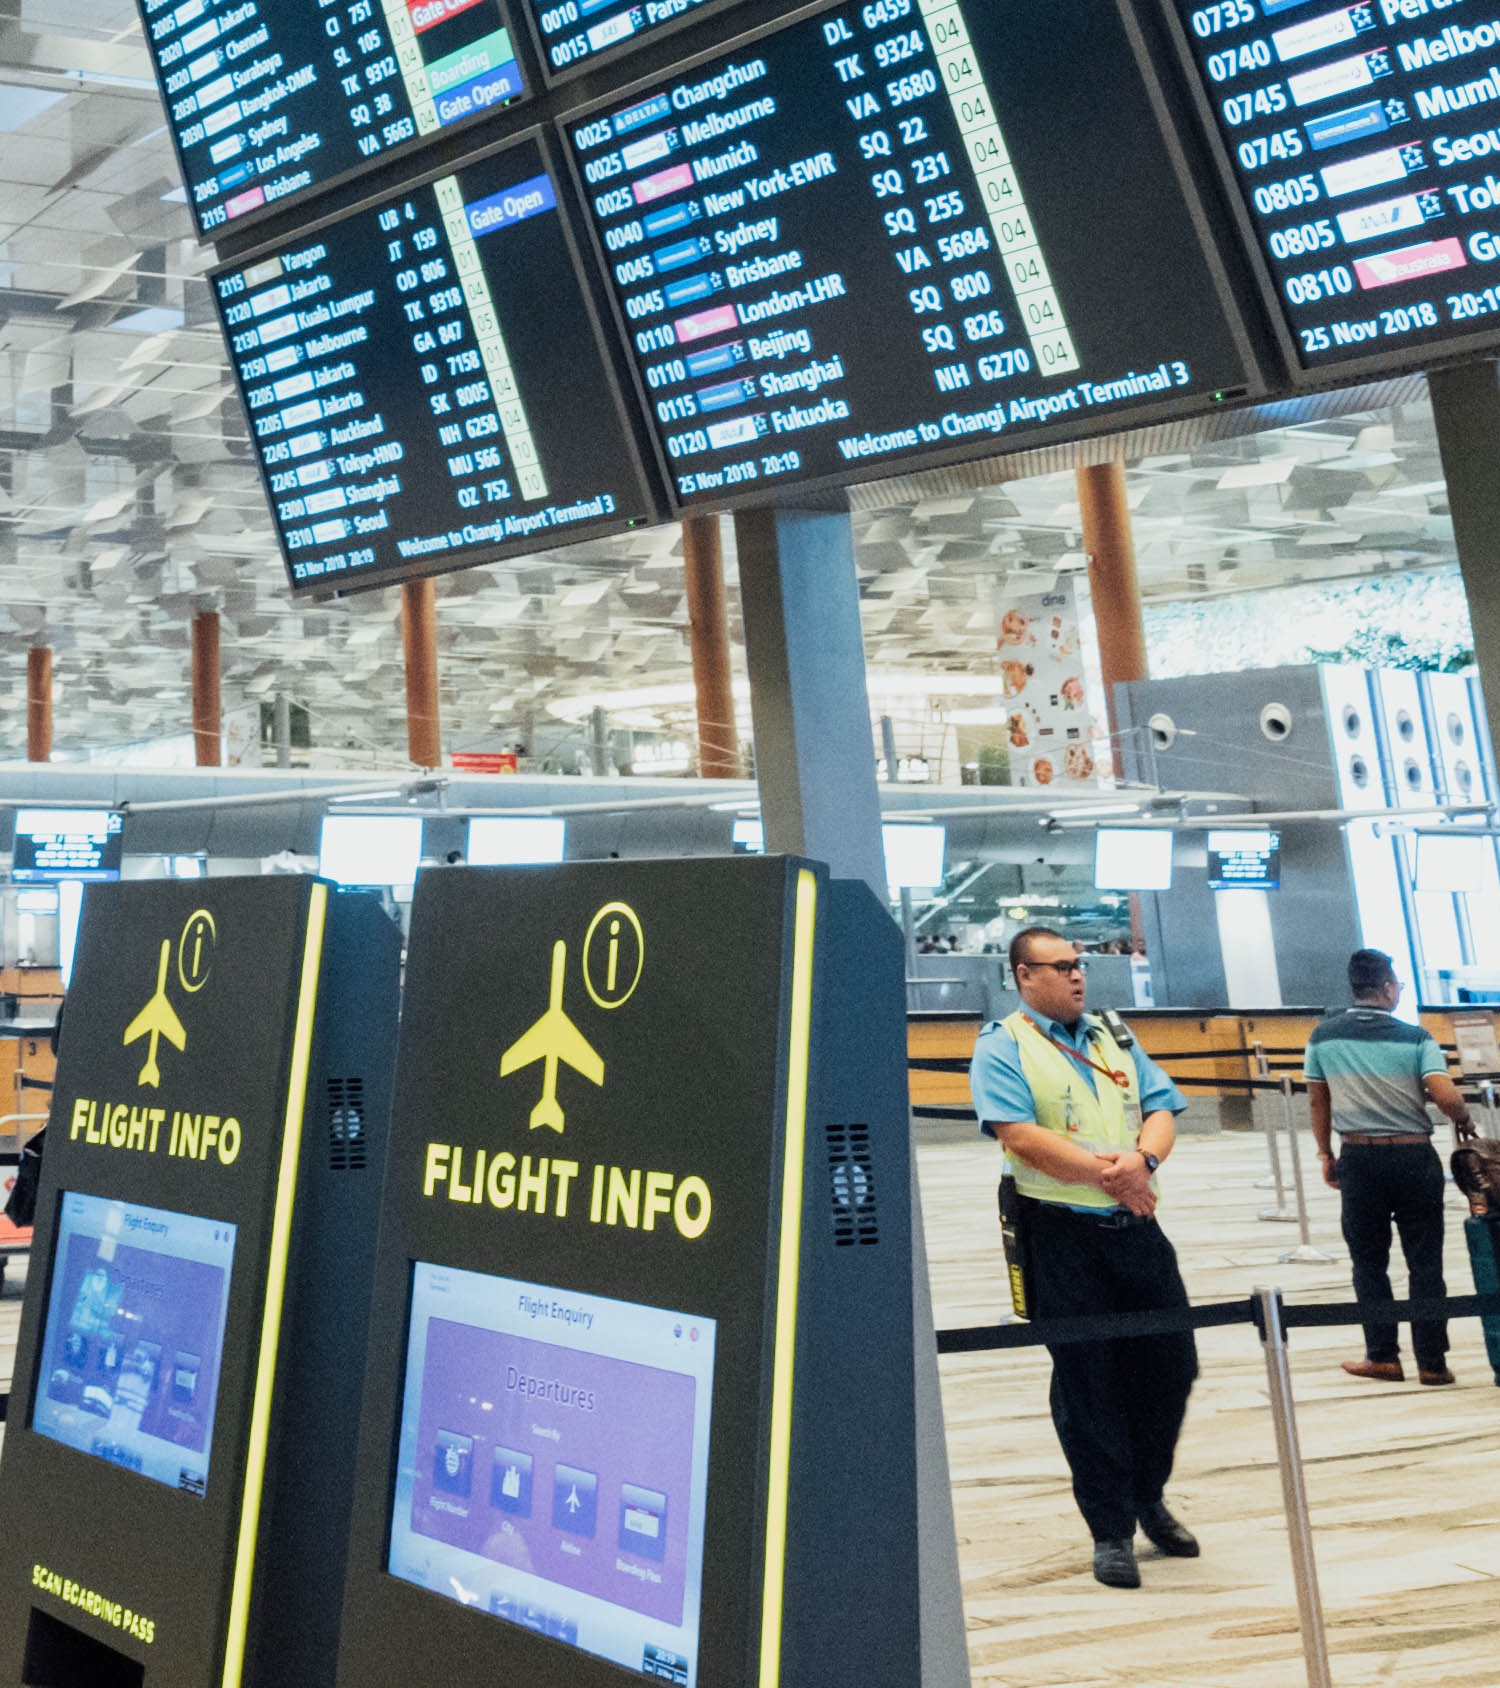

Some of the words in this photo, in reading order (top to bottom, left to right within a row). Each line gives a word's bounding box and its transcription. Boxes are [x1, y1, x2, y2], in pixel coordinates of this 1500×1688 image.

[575, 119, 612, 150] 0025
[672, 59, 766, 110] Changchun
[823, 18, 853, 46] DL
[1286, 266, 1352, 304] 0810
[1300, 326, 1330, 352] 25
[1331, 320, 1378, 345] Nov
[1379, 302, 1438, 335] 2018
[28, 1042, 37, 1056] 3
[70, 1098, 166, 1153] FLIGHT
[168, 1112, 242, 1165] INFO
[423, 1143, 579, 1217] FLIGHT
[590, 1164, 712, 1239] INFO
[518, 1294, 549, 1320] Flight
[551, 1301, 594, 1330] Enquiry
[507, 1366, 595, 1411] Departures
[32, 1564, 62, 1597] SCAN
[122, 1609, 156, 1644] PASS
